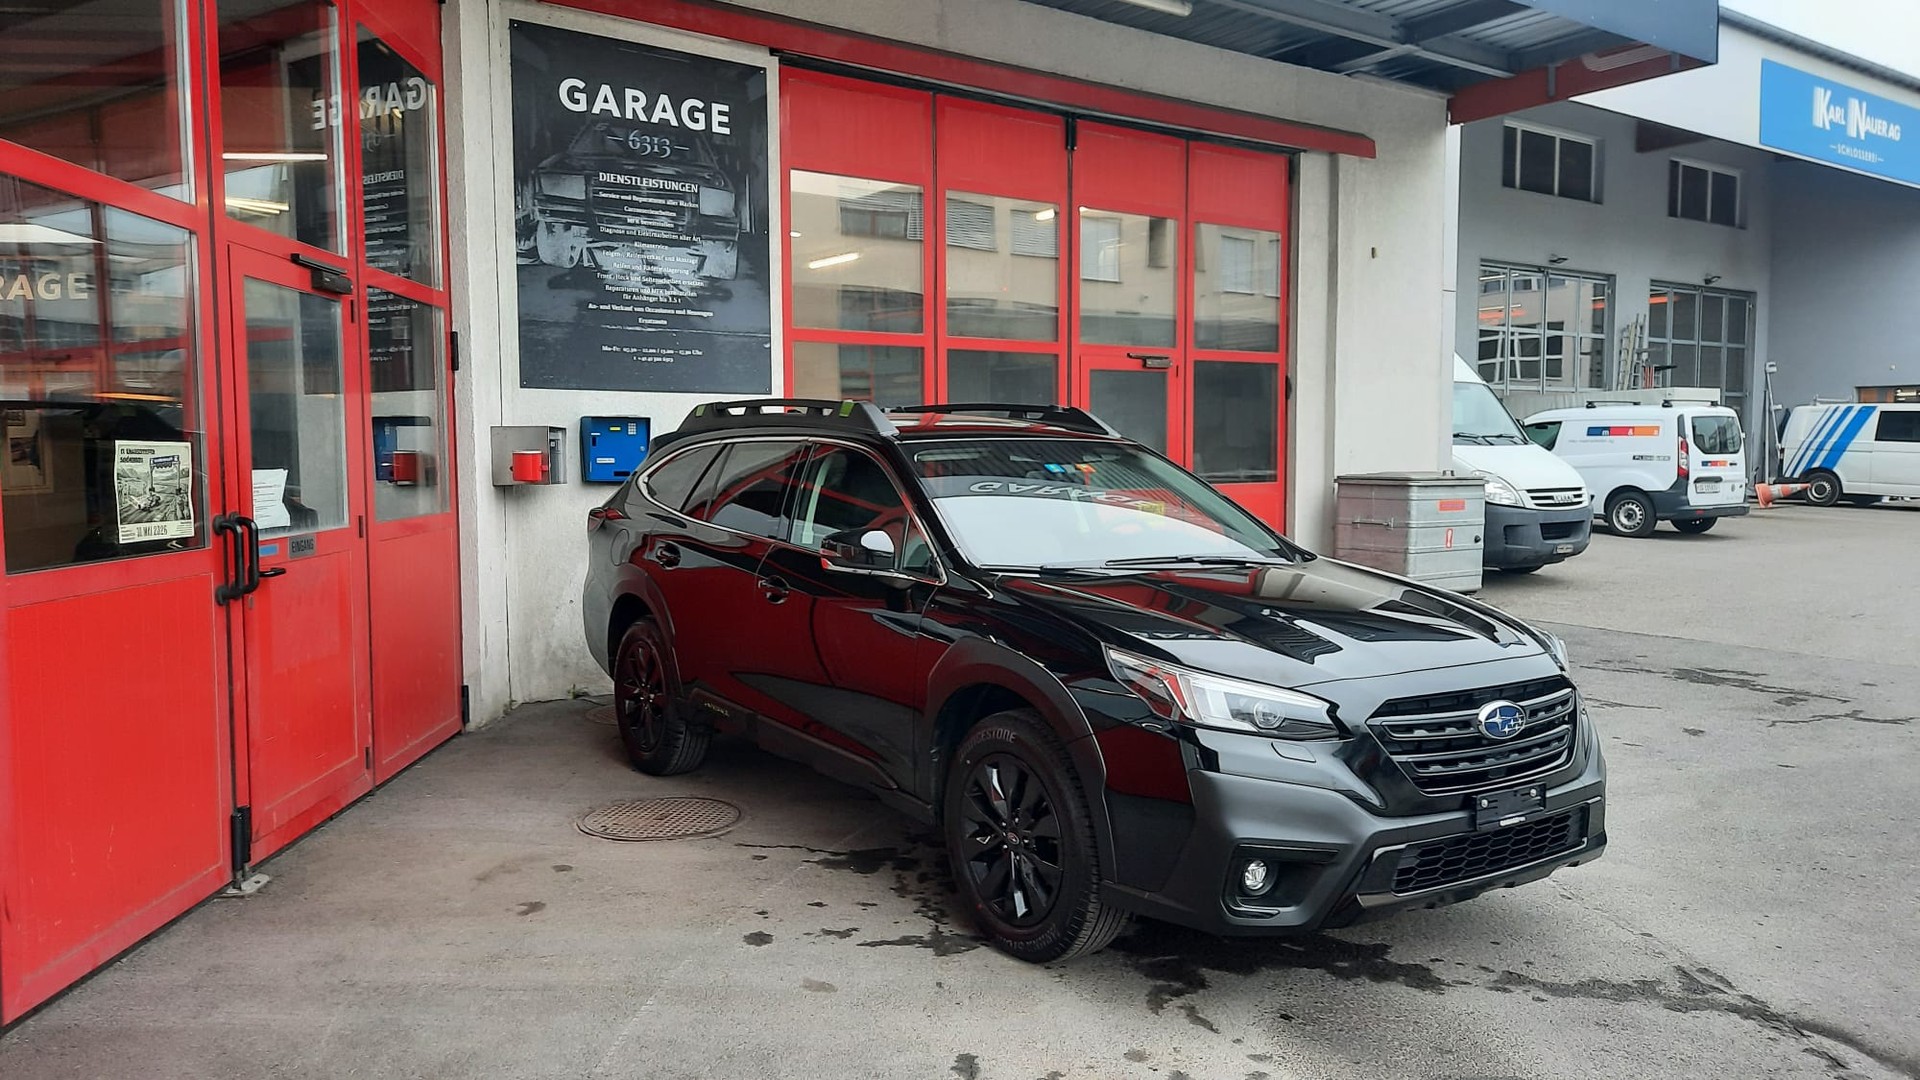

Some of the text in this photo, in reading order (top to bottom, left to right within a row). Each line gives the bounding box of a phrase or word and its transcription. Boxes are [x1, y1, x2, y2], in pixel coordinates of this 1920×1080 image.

[558, 77, 731, 135] GARAGE
[1888, 122, 1901, 142] AG
[628, 129, 672, 159] 6313
[1837, 143, 1878, 163] SCHLOSSEREI
[599, 172, 697, 193] DIENSTLEISTUNGEN
[632, 195, 665, 205] Reparaturen
[599, 226, 624, 235] Diagnose
[637, 229, 678, 240] Elektroarbeiten
[634, 241, 668, 250] Klimaservice
[612, 261, 630, 269] Reifen
[605, 284, 639, 294] Reparaturen
[682, 279, 704, 287] ersetzen
[632, 294, 657, 303] Anhänger
[292, 538, 314, 553] EINGANG
